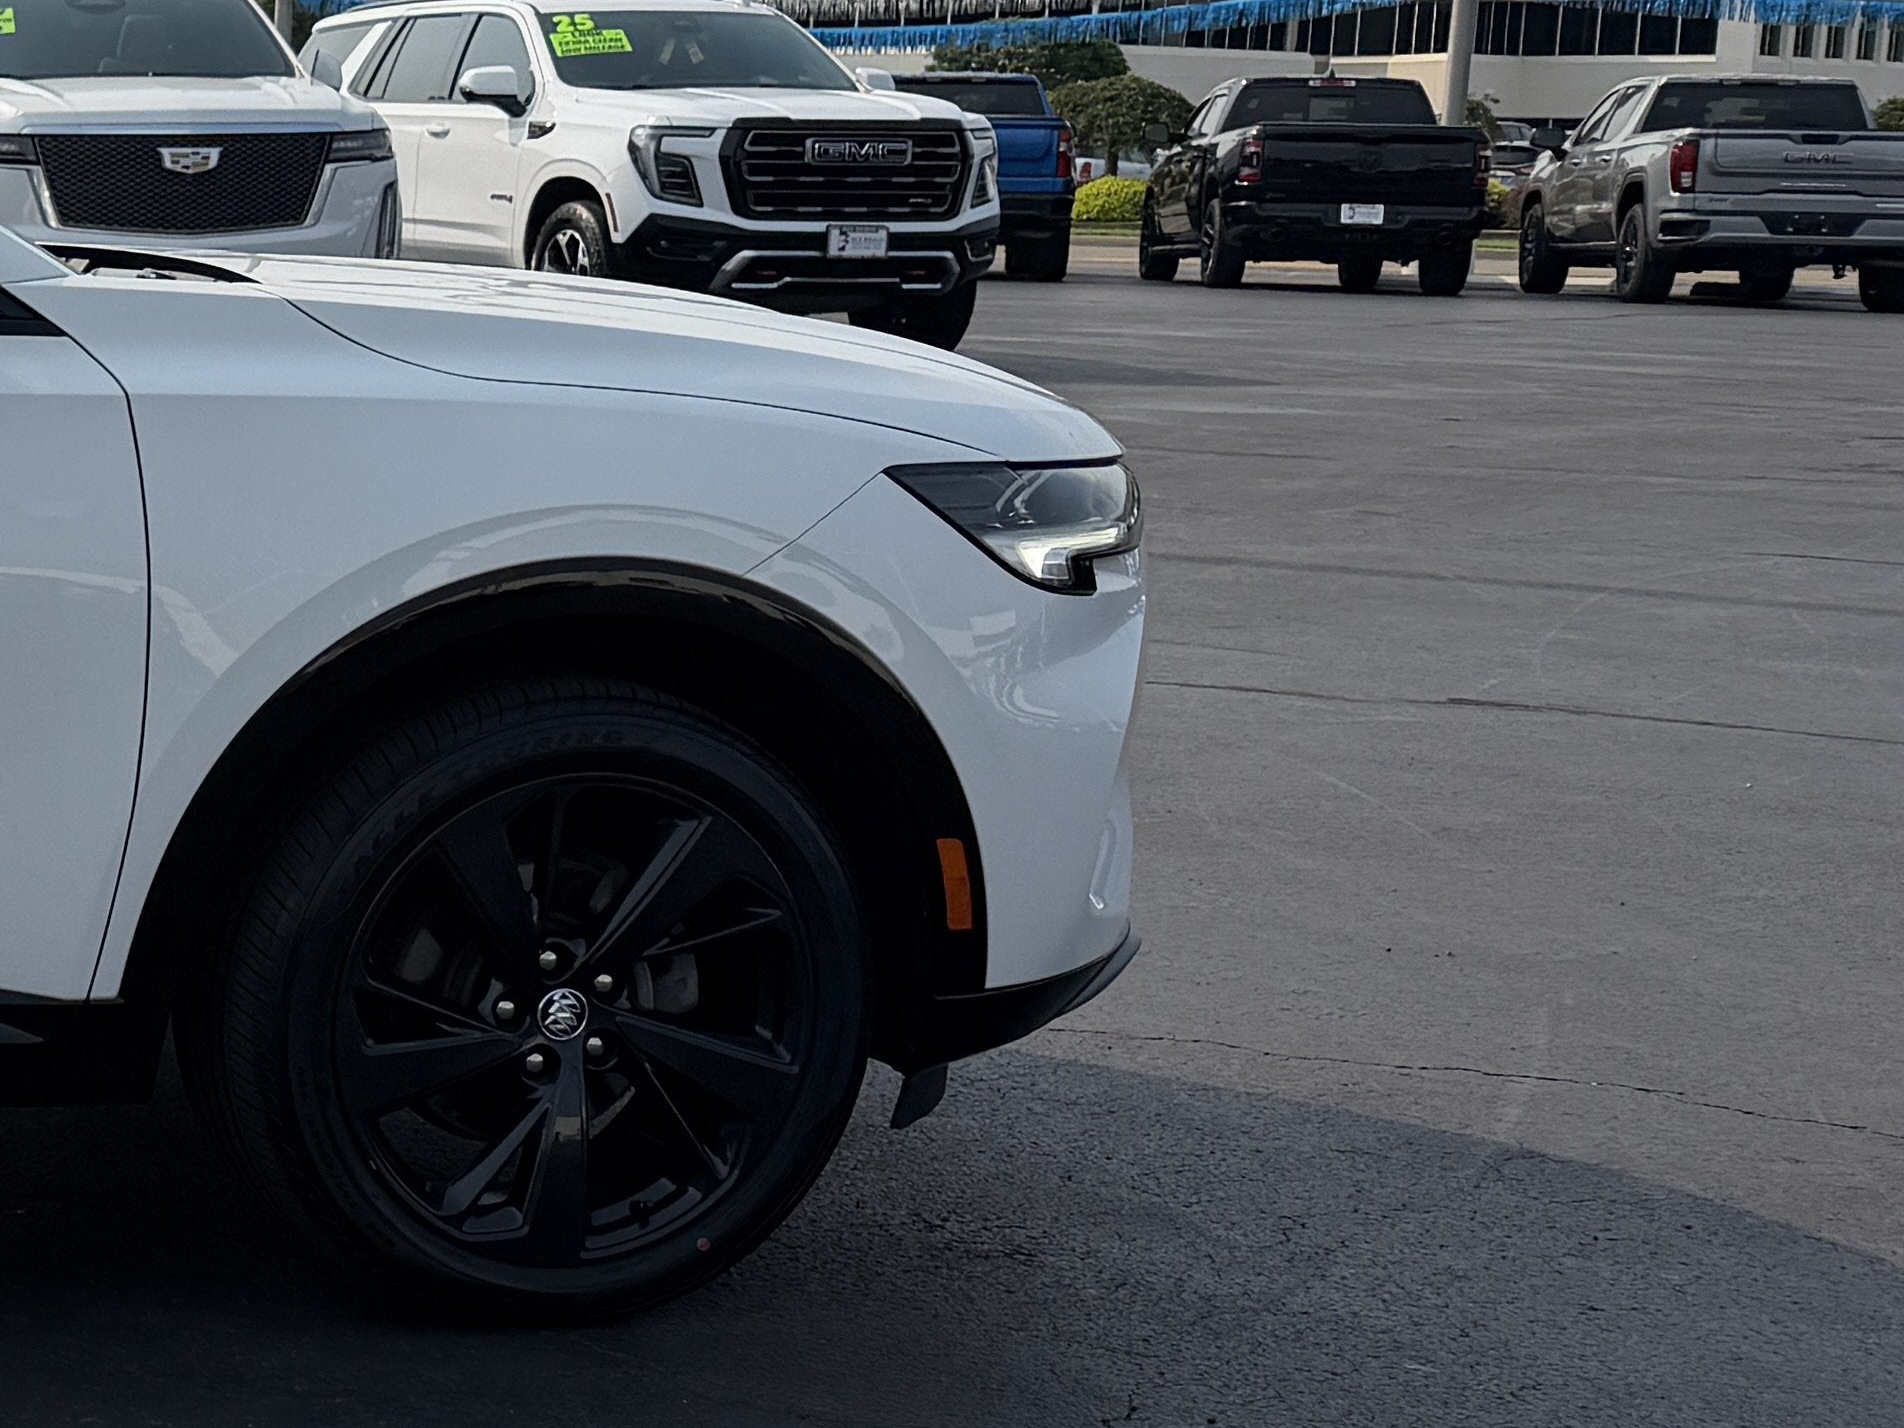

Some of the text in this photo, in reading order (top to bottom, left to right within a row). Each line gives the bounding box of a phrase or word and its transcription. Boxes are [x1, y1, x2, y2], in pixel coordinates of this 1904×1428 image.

[552, 13, 595, 32] 25
[814, 142, 908, 162] GMC
[1782, 151, 1854, 164] GMC
